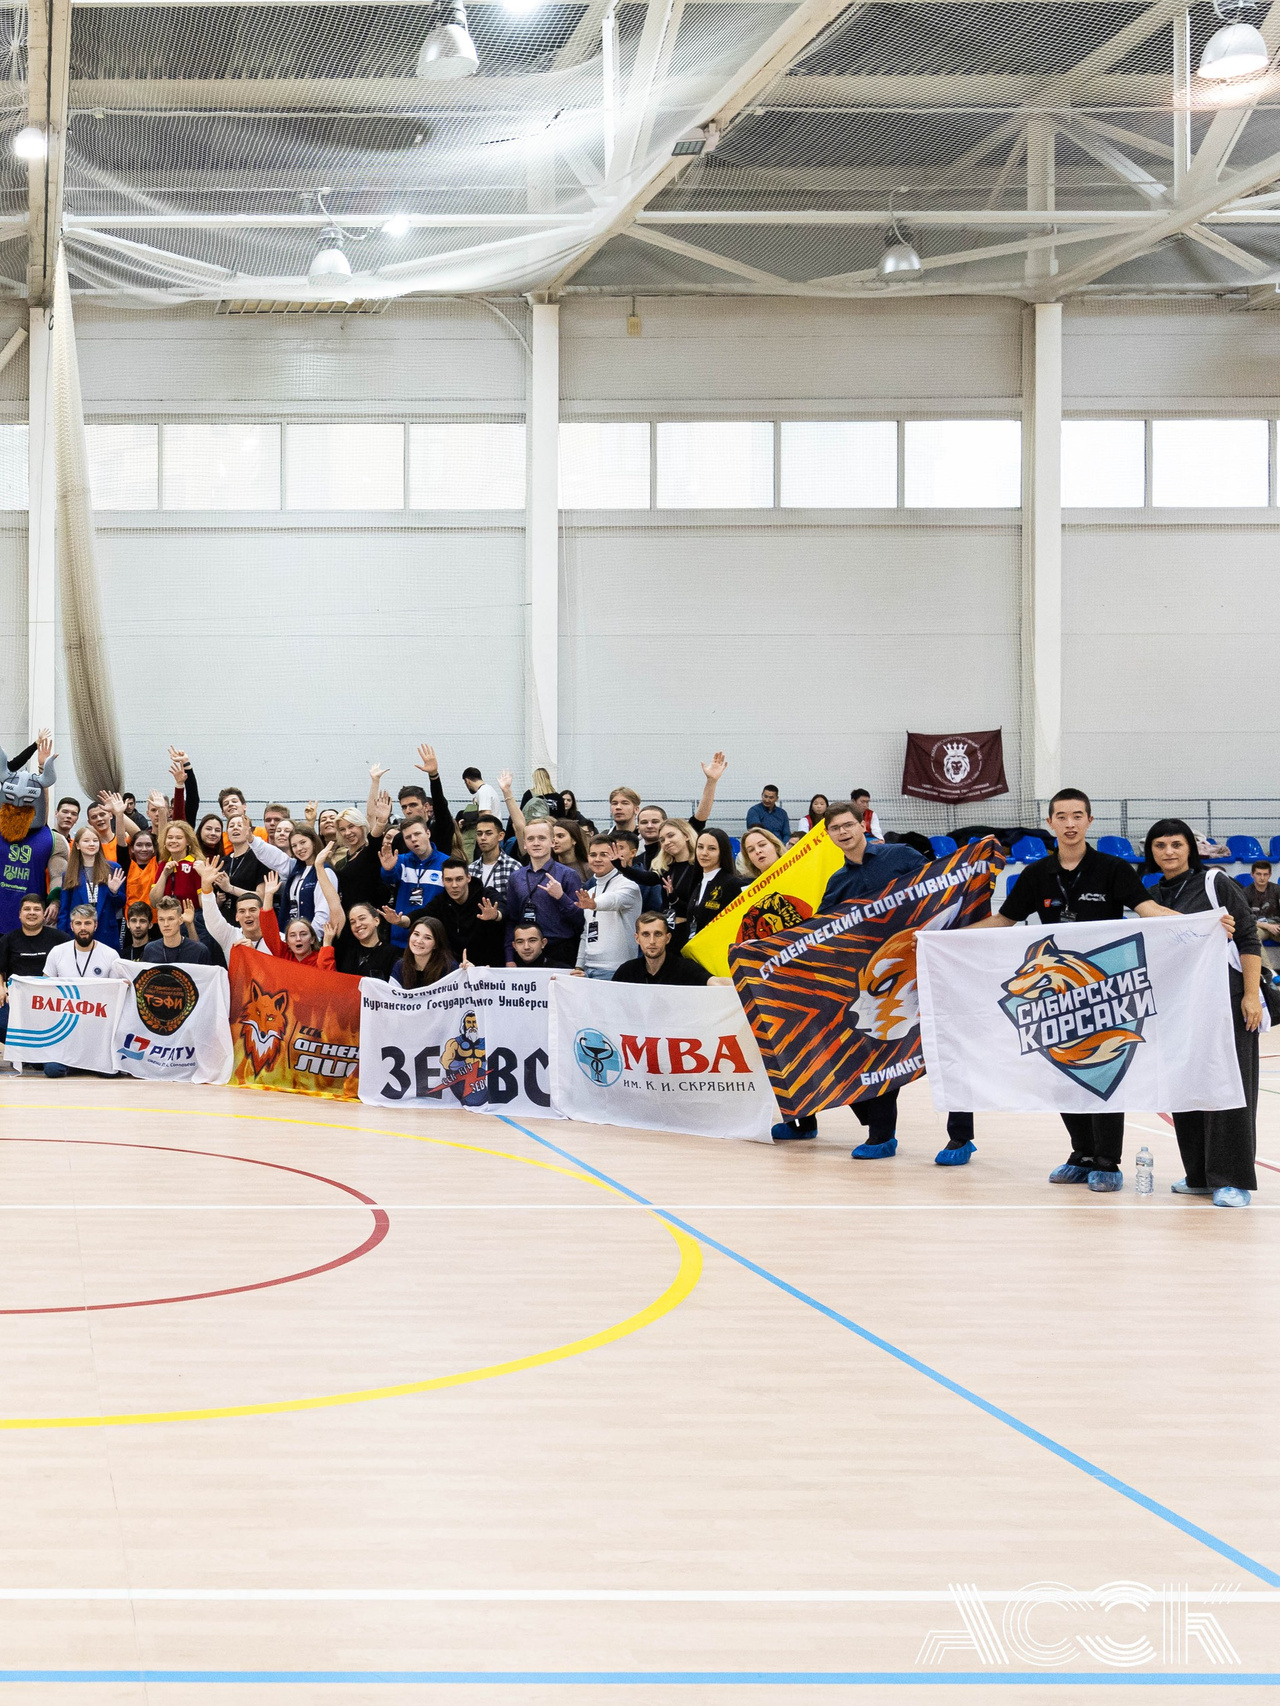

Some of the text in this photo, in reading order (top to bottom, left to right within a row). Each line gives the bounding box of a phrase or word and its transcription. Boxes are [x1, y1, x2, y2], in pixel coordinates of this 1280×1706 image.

[8, 844, 32, 864] 99
[759, 862, 973, 981] СТУДЕНЧЕСКИЙ СПОРТИВНЫЙ
[511, 981, 536, 994] клуб
[1018, 967, 1150, 1025] СИБИРСКИЕ
[144, 993, 183, 1010] ТЭФИ
[363, 997, 422, 1011] Курганского
[1019, 988, 1156, 1053] КОРСАКИ
[620, 1034, 753, 1075] МВА
[646, 1082, 658, 1091] К.
[661, 1083, 675, 1092] И.
[679, 1081, 756, 1092] СКРЯБИНА
